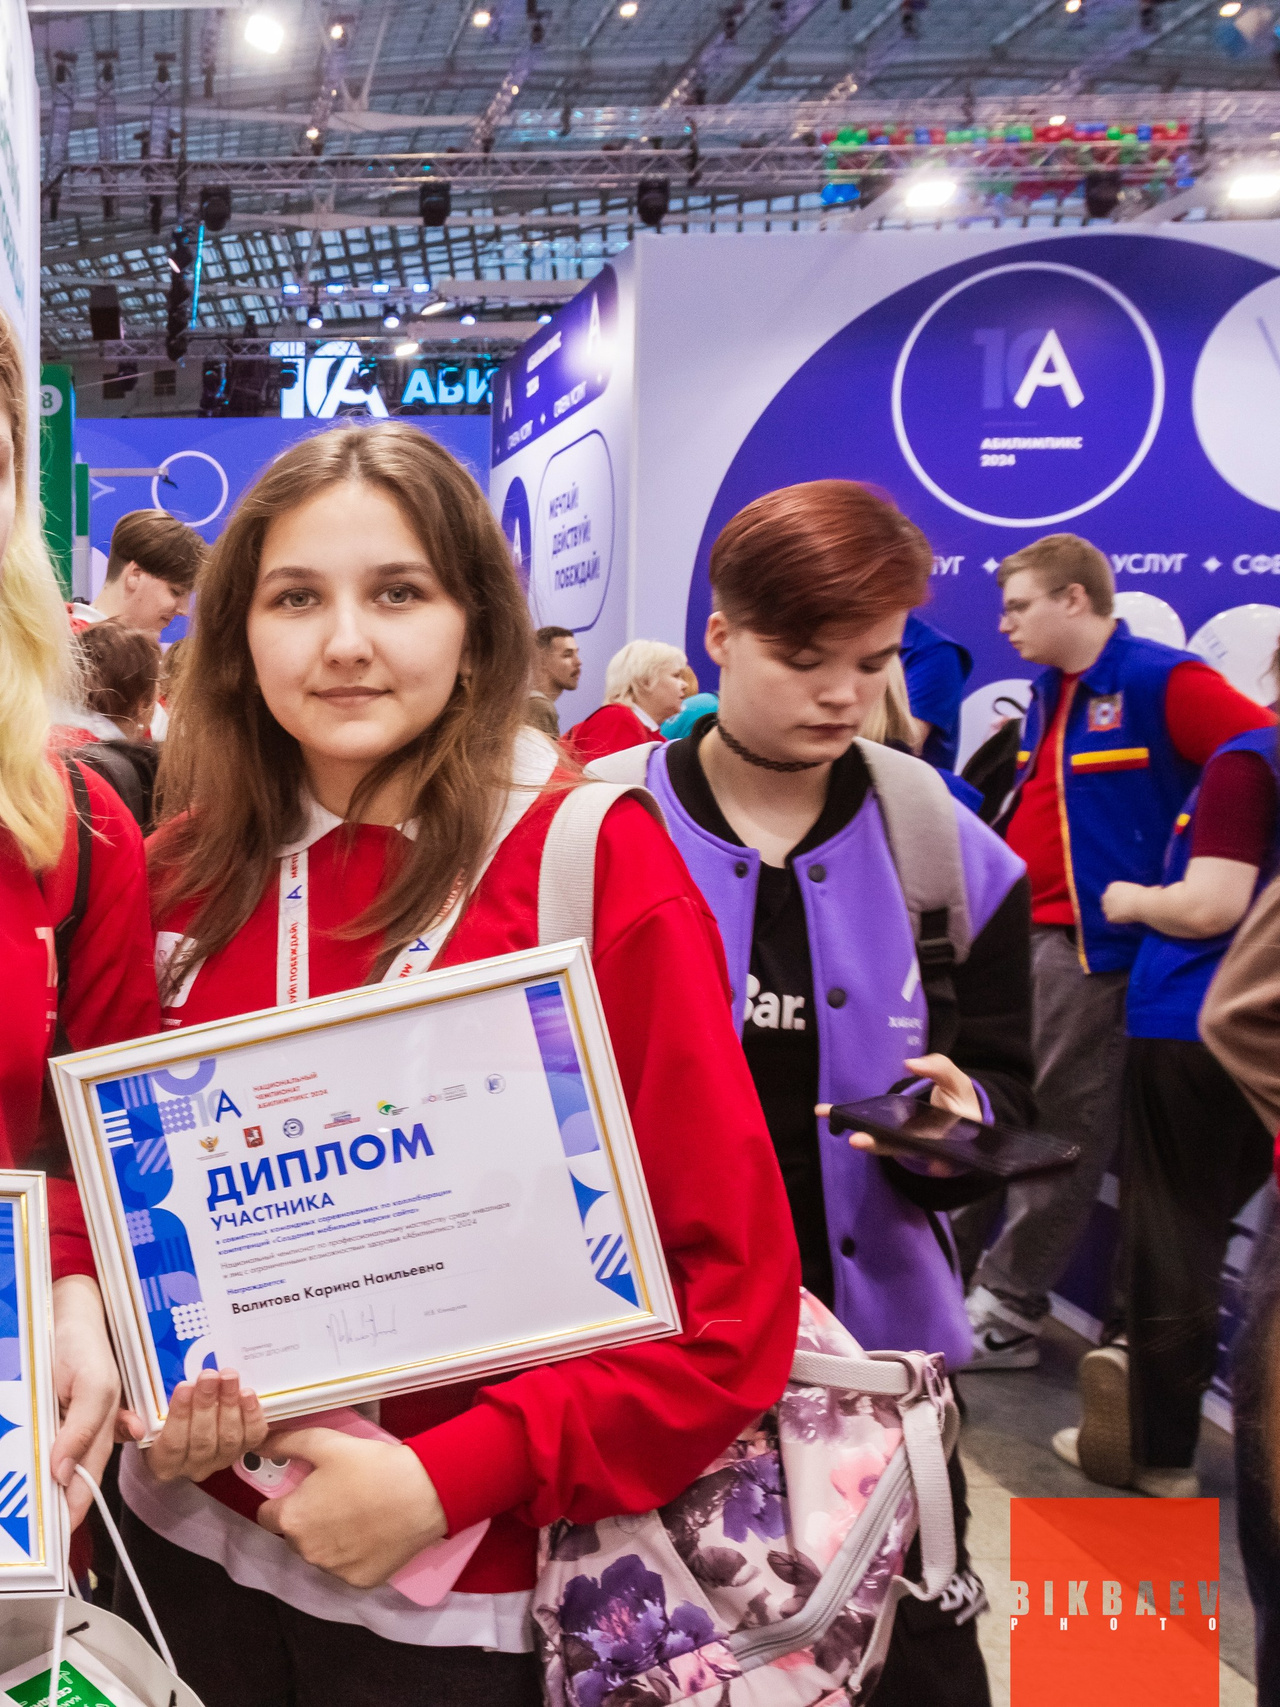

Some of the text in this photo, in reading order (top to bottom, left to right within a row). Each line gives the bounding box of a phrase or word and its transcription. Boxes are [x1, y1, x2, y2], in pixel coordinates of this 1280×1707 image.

[206, 1122, 435, 1212] ДИПЛОМ
[210, 1192, 335, 1231] УЧАСТНИКА
[231, 1261, 445, 1315] Валитова Карина Наильевна
